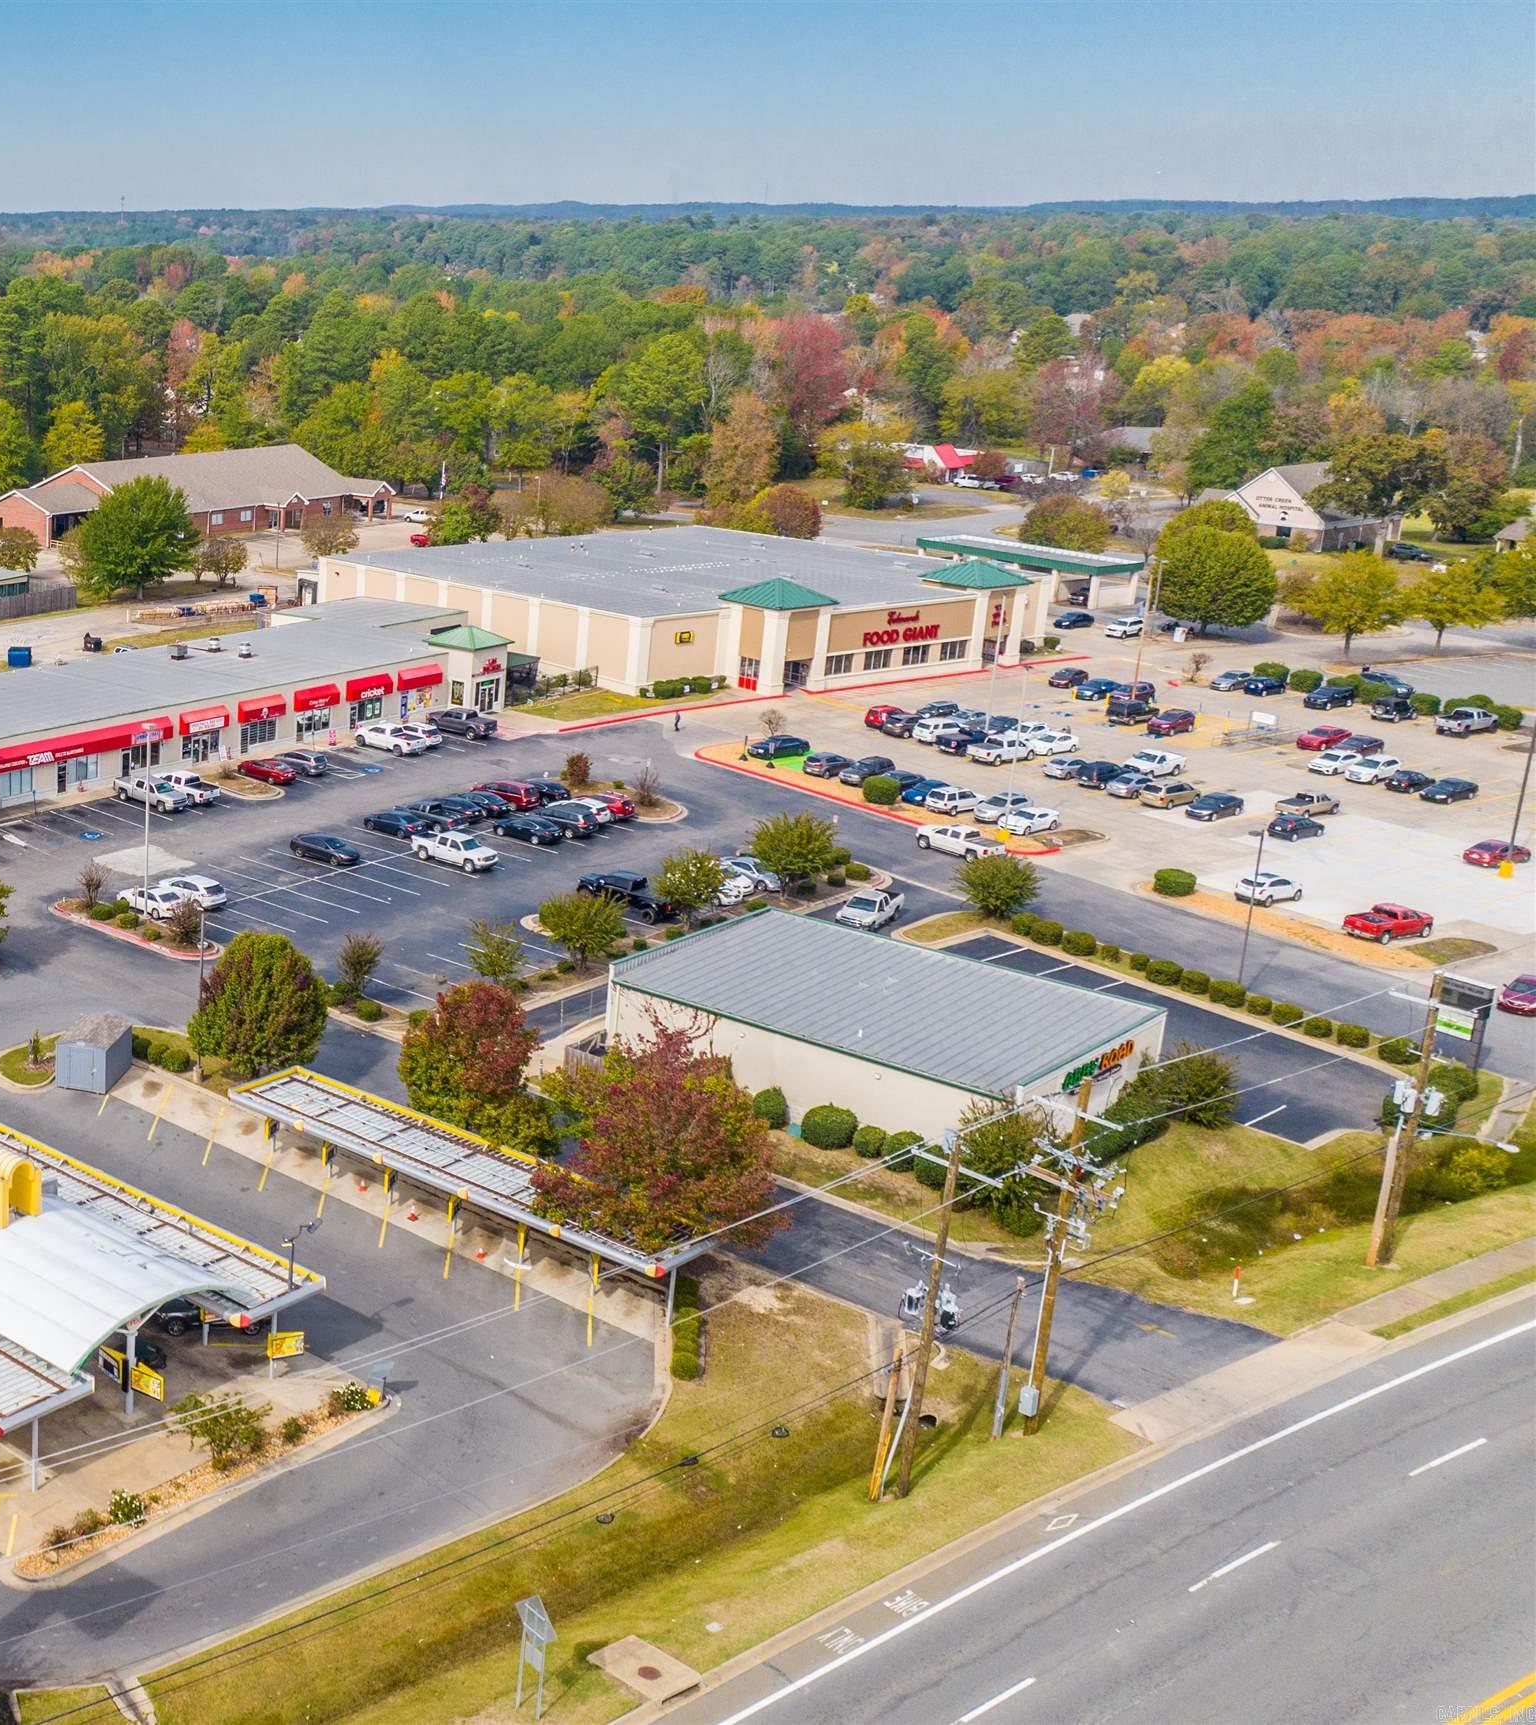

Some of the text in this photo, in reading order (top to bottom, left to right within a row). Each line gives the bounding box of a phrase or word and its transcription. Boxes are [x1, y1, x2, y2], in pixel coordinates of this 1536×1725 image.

[862, 624, 941, 647] FOOD GIANT
[360, 686, 385, 699] cricket
[26, 751, 55, 766] TEAM
[1098, 1039, 1135, 1071] ROAD
[815, 1625, 866, 1655] ONLY
